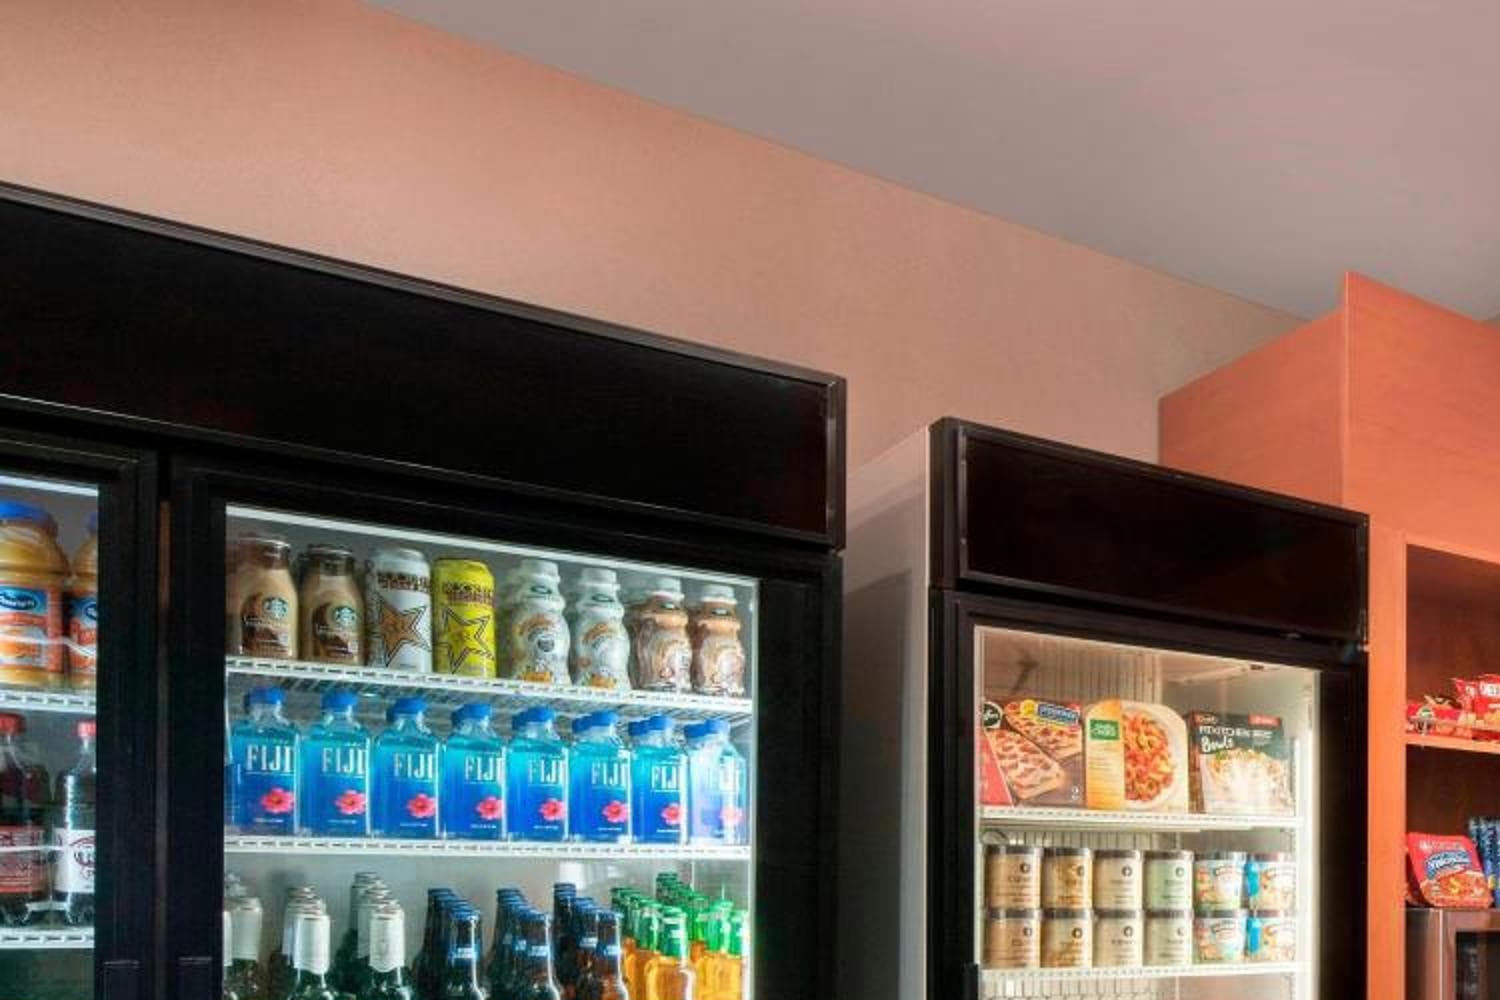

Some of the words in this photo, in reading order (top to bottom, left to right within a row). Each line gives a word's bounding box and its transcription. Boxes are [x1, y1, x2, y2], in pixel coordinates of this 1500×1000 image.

[246, 744, 293, 772] FIJI
[322, 747, 366, 774] FIJI
[393, 752, 435, 779] FIJI
[464, 755, 503, 782] FIJI
